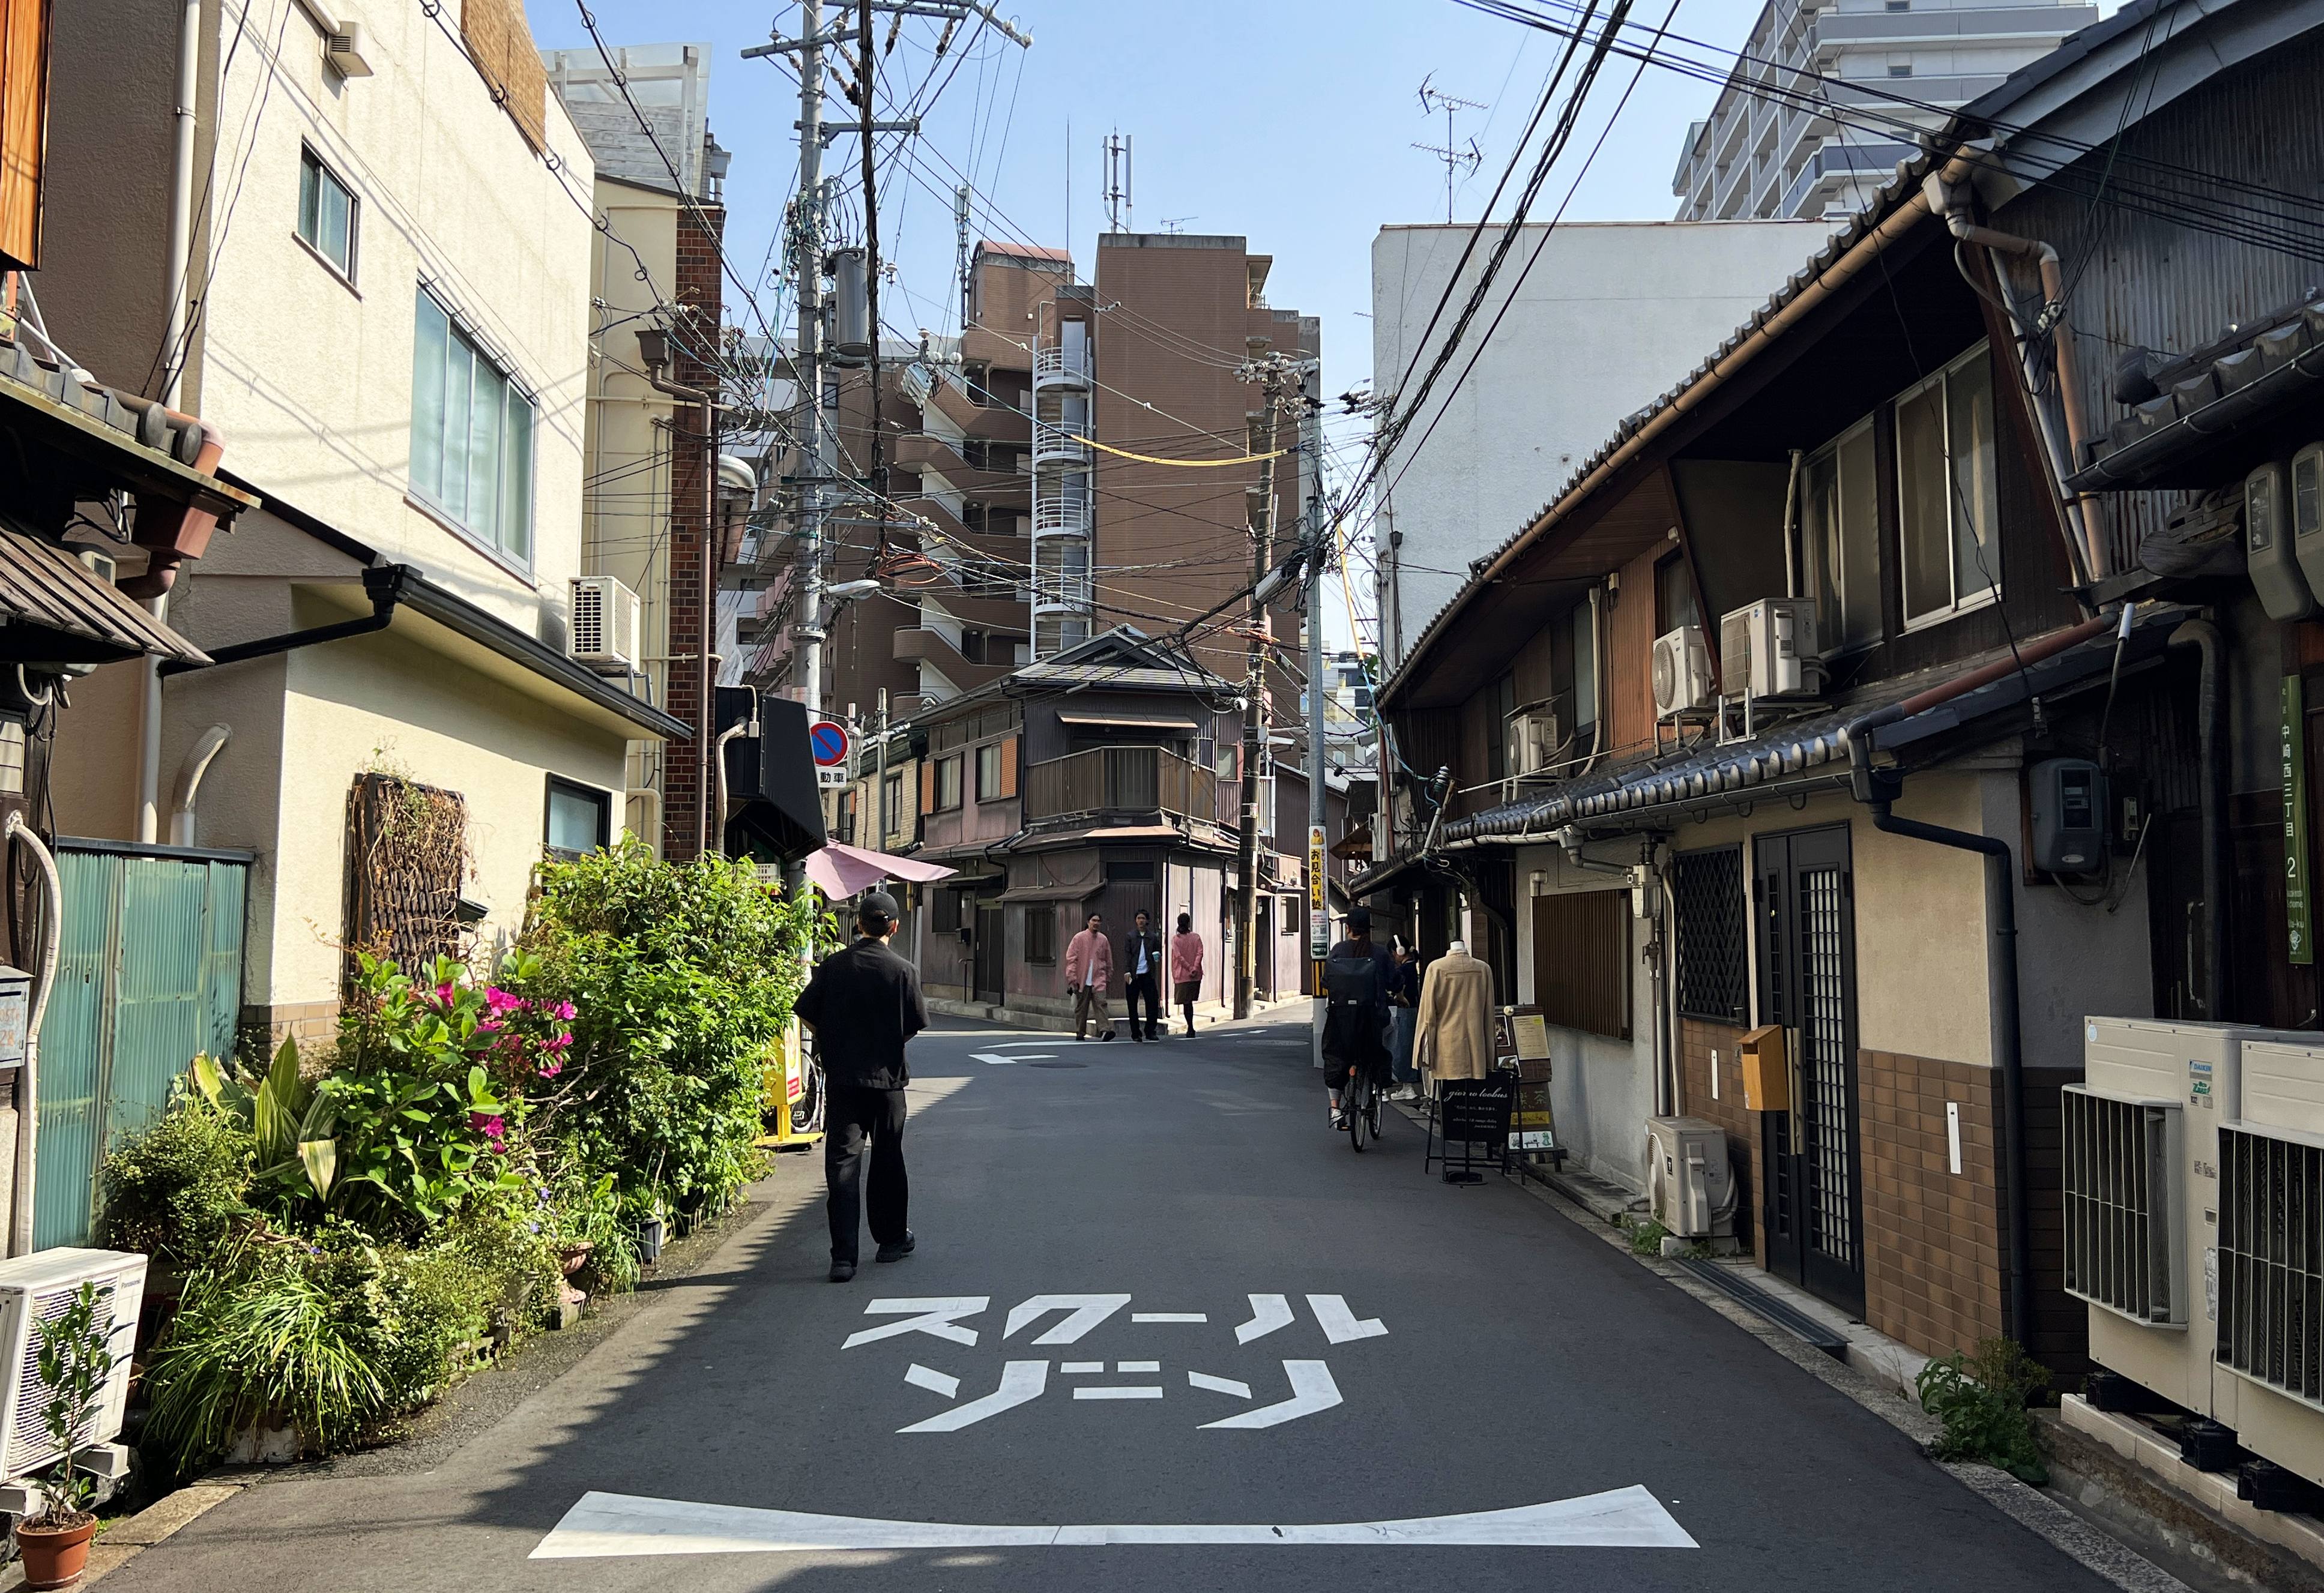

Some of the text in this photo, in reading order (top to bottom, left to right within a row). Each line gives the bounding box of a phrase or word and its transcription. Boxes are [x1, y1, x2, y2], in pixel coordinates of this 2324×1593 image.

[1311, 849, 1321, 910] お見合い塾
[2287, 857, 2296, 878] 2
[841, 1294, 1389, 1349] スクール
